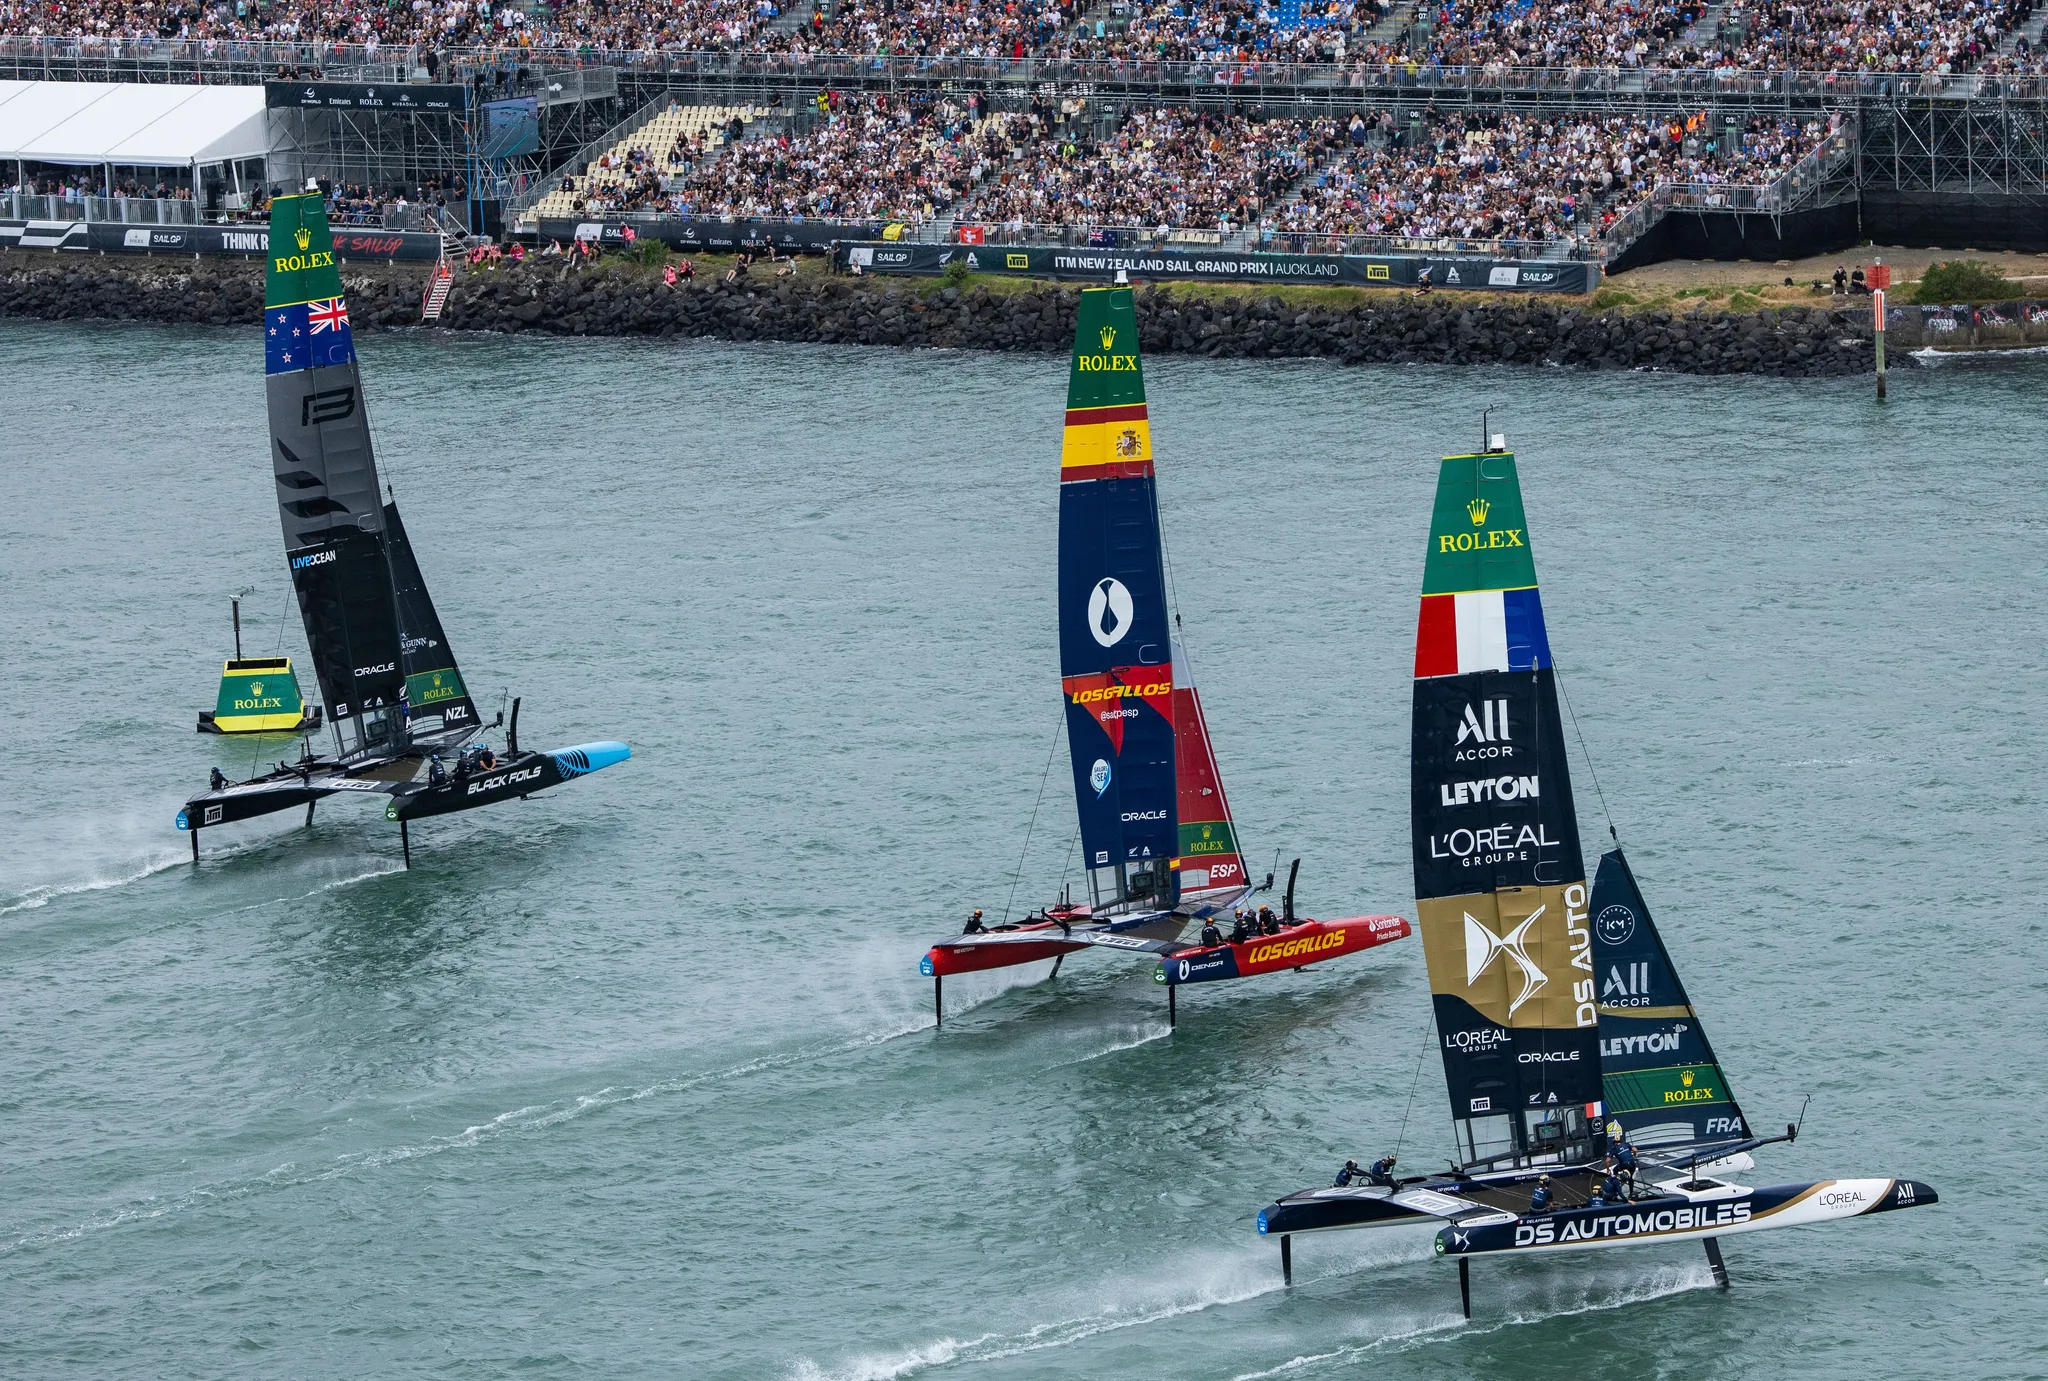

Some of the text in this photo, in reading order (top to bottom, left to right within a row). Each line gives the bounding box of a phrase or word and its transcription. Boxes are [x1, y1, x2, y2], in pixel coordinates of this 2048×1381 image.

[222, 232, 260, 250] THINK
[275, 252, 334, 272] ROLEX
[1055, 256, 1338, 276] ITM NEW ZEALAND SAIL GRAND PRIX AUCKLAND
[1079, 356, 1137, 371] ROLEX
[1439, 529, 1523, 553] ROLEX
[354, 663, 394, 677] ORACLE
[423, 686, 454, 699] ROLEX
[234, 698, 282, 710] ROLEX
[446, 706, 468, 721] NZL
[1455, 746, 1513, 762] ACCOR
[467, 766, 542, 796] BLACK FOILS
[1441, 775, 1540, 806] LEYTON
[1121, 810, 1166, 822] ORACLE
[1190, 841, 1224, 852] ROLEX
[1430, 823, 1560, 858] L'ORÉAL
[1462, 852, 1527, 867] GROUPE
[1210, 864, 1237, 878] ESP
[1375, 917, 1400, 930] Santander
[1249, 929, 1346, 964] LOSGALLOS
[1564, 884, 1597, 1027] DS AUTO
[1191, 960, 1223, 971] DENZA
[1601, 997, 1650, 1009] ACCOR
[1446, 1029, 1511, 1048] L'ORÉAL
[1600, 1033, 1679, 1056] LEYTON
[1462, 1043, 1497, 1052] GROUPE
[1518, 1050, 1580, 1063] ORACLE
[1664, 1088, 1713, 1102] ROLEX
[1706, 1117, 1742, 1134] FRA
[1819, 1191, 1866, 1206] L'ORÉAL
[1515, 1202, 1752, 1247] DS AUTOMOBILES
